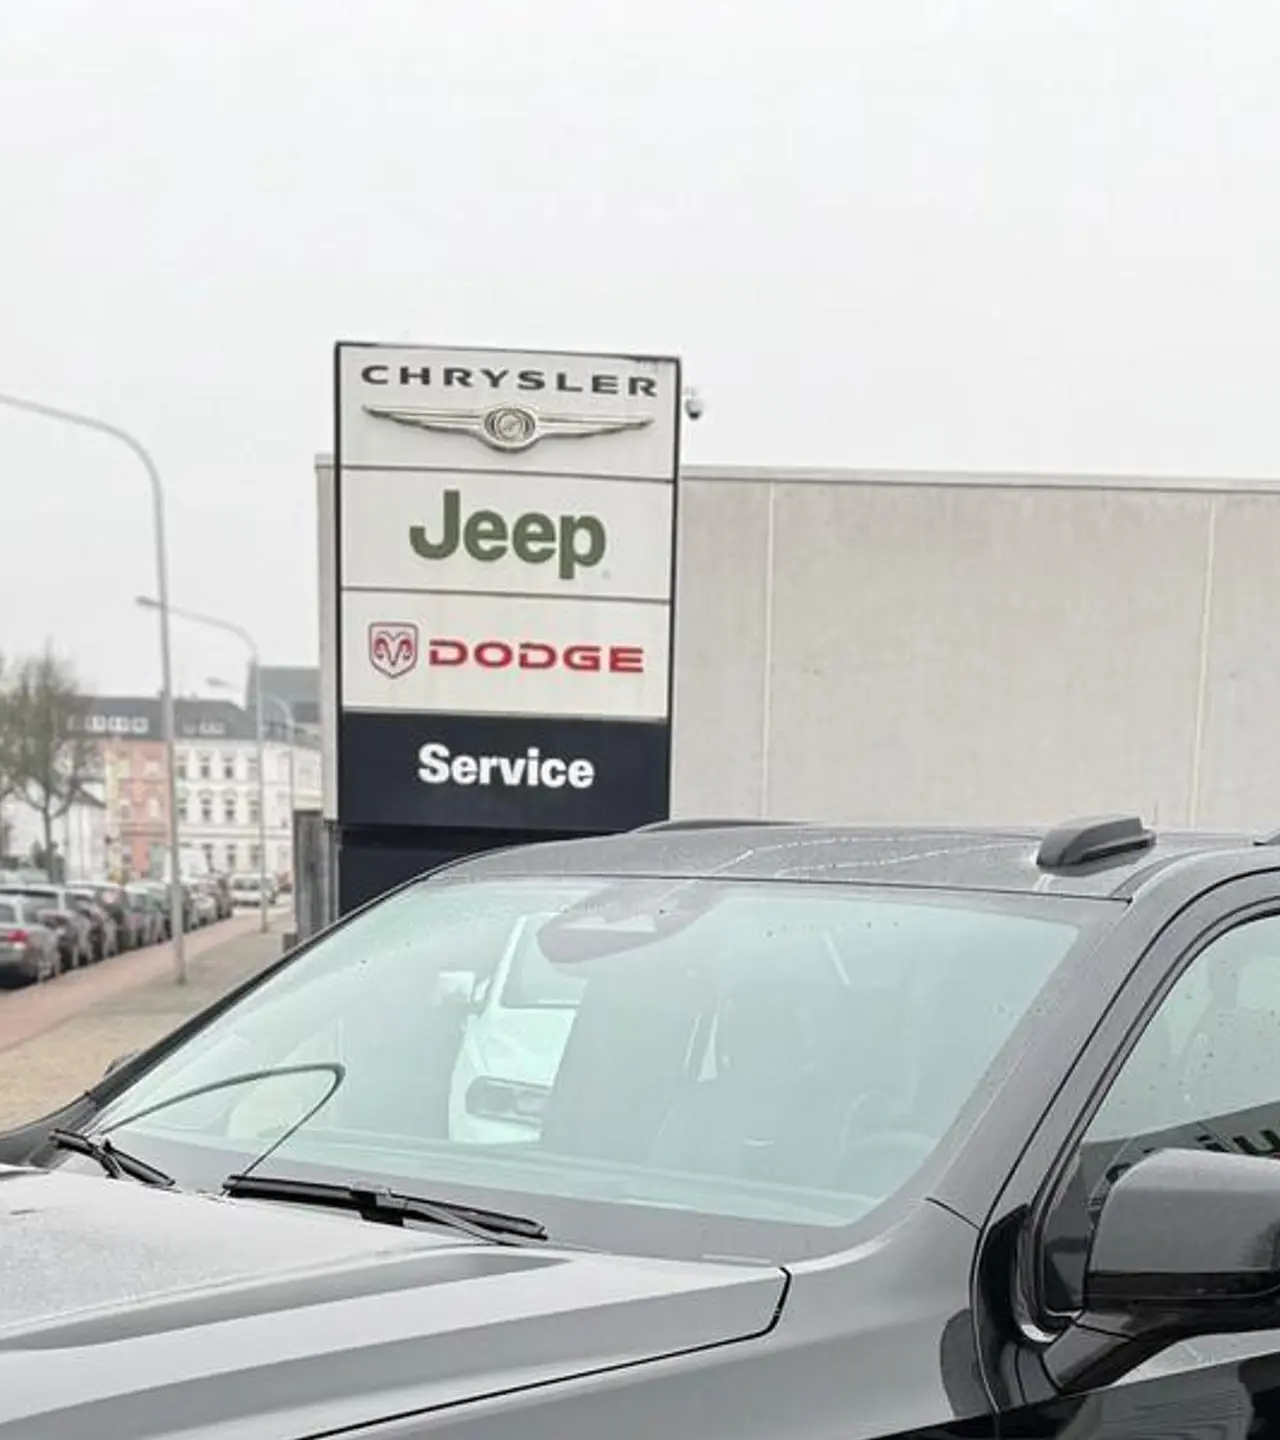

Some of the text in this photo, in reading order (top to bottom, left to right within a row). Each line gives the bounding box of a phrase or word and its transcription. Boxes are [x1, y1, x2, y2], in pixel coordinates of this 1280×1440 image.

[361, 364, 658, 398] CHRYSLER
[409, 489, 607, 580] Jeep
[428, 638, 645, 674] DODGE
[417, 742, 596, 789] Service
